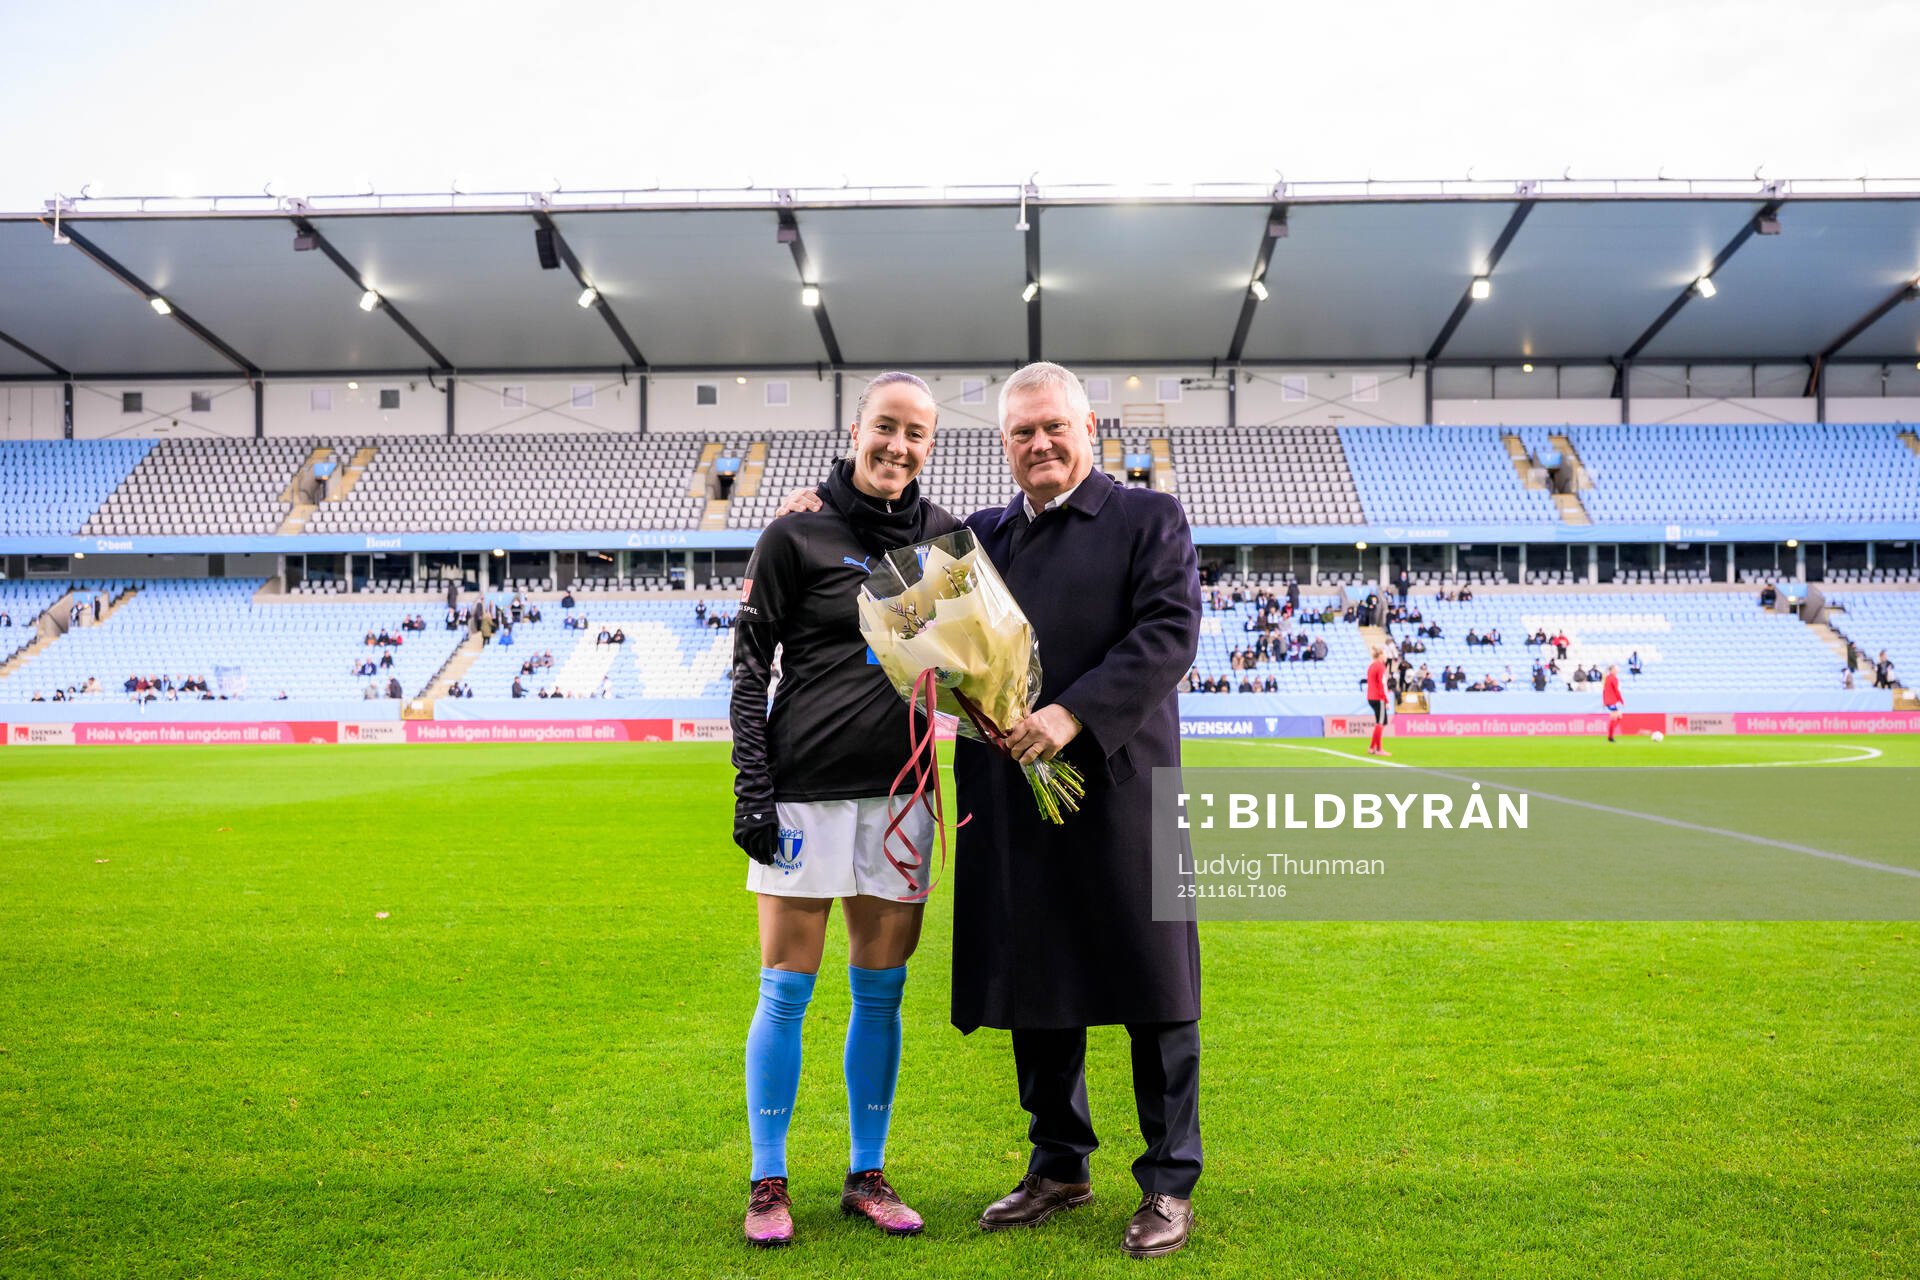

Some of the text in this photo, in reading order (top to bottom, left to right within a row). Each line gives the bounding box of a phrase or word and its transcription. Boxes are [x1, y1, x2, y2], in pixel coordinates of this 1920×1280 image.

[743, 605, 758, 615] SPEL
[417, 725, 615, 741] Hela vägen från ungdom till elit
[1180, 721, 1253, 735] SVENSKAN
[1406, 719, 1437, 733] Hela
[1482, 719, 1508, 733] från
[1510, 720, 1566, 735] ungdom
[1568, 719, 1585, 732] till
[1747, 718, 1777, 730] Hela
[1850, 717, 1906, 733] ungdom
[86, 727, 280, 743] Hela vägen från ungdom till elit
[760, 1107, 788, 1116] MFF
